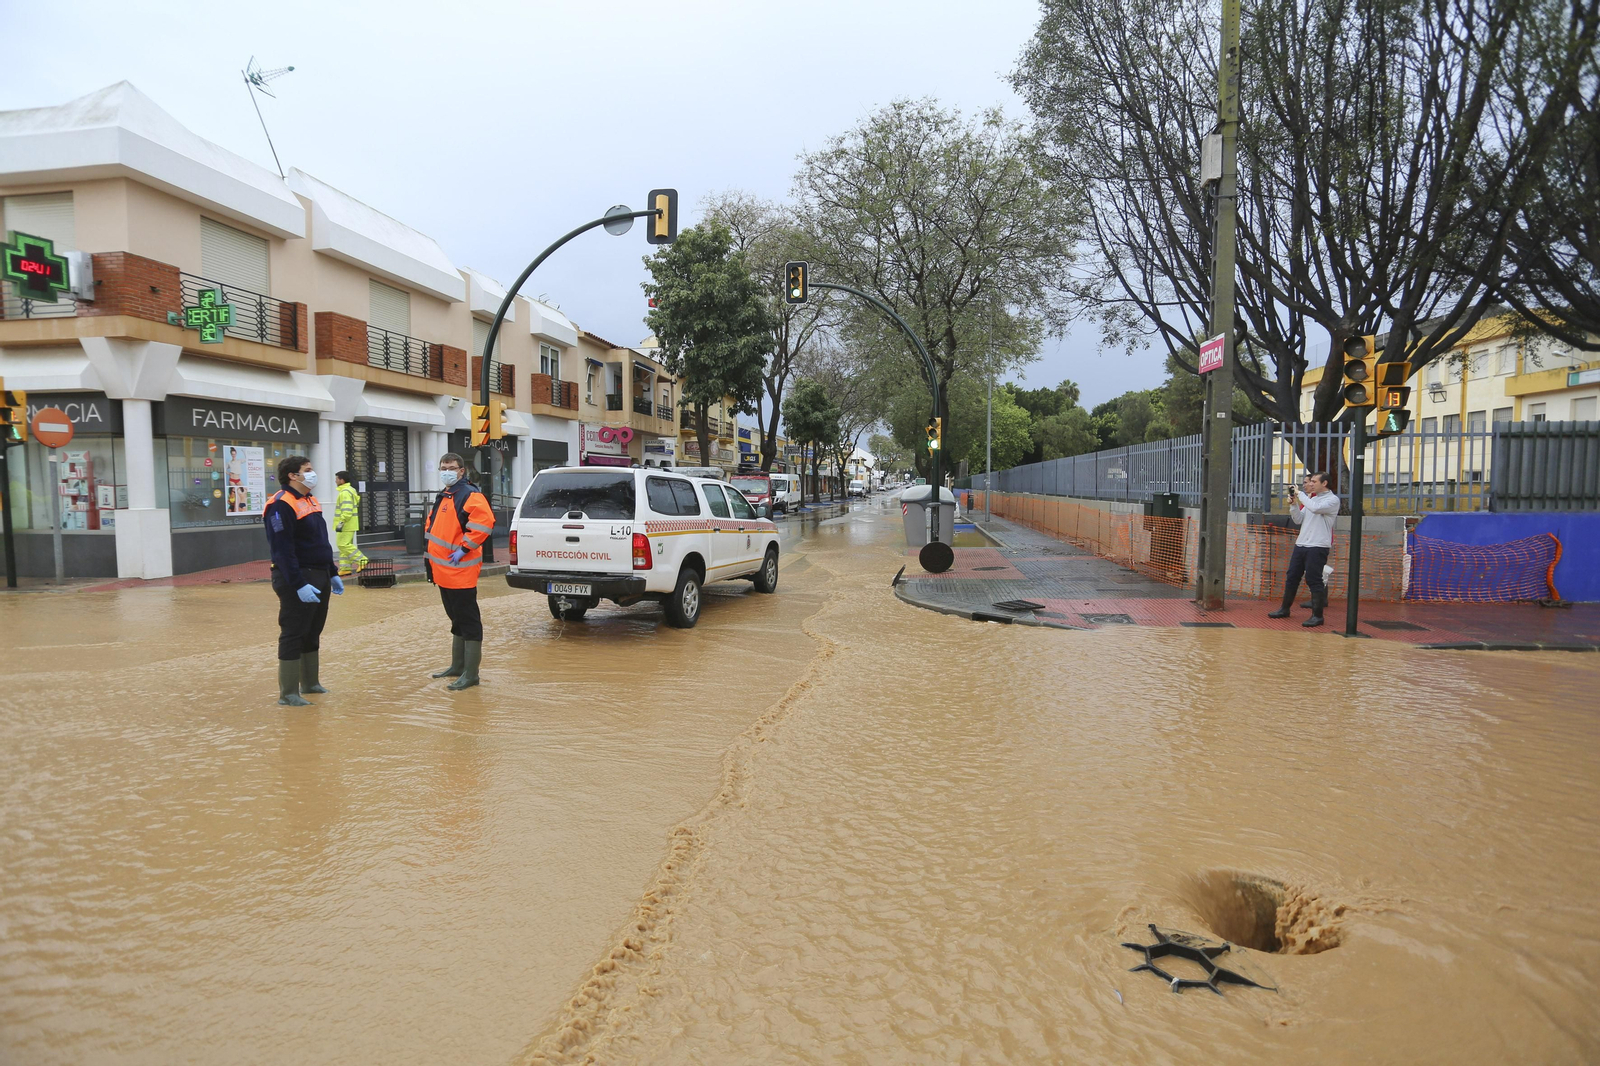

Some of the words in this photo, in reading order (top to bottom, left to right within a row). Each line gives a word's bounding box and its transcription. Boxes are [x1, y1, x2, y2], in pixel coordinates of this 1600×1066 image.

[1200, 345, 1222, 367] OPTICA
[1388, 392, 1400, 407] 13
[192, 408, 300, 435] FARMACIA
[611, 526, 632, 536] L-10
[536, 550, 588, 559] PROTECCIÓN
[590, 552, 611, 561] CIVIL
[554, 584, 573, 593] 0049
[574, 585, 588, 594] FVX
